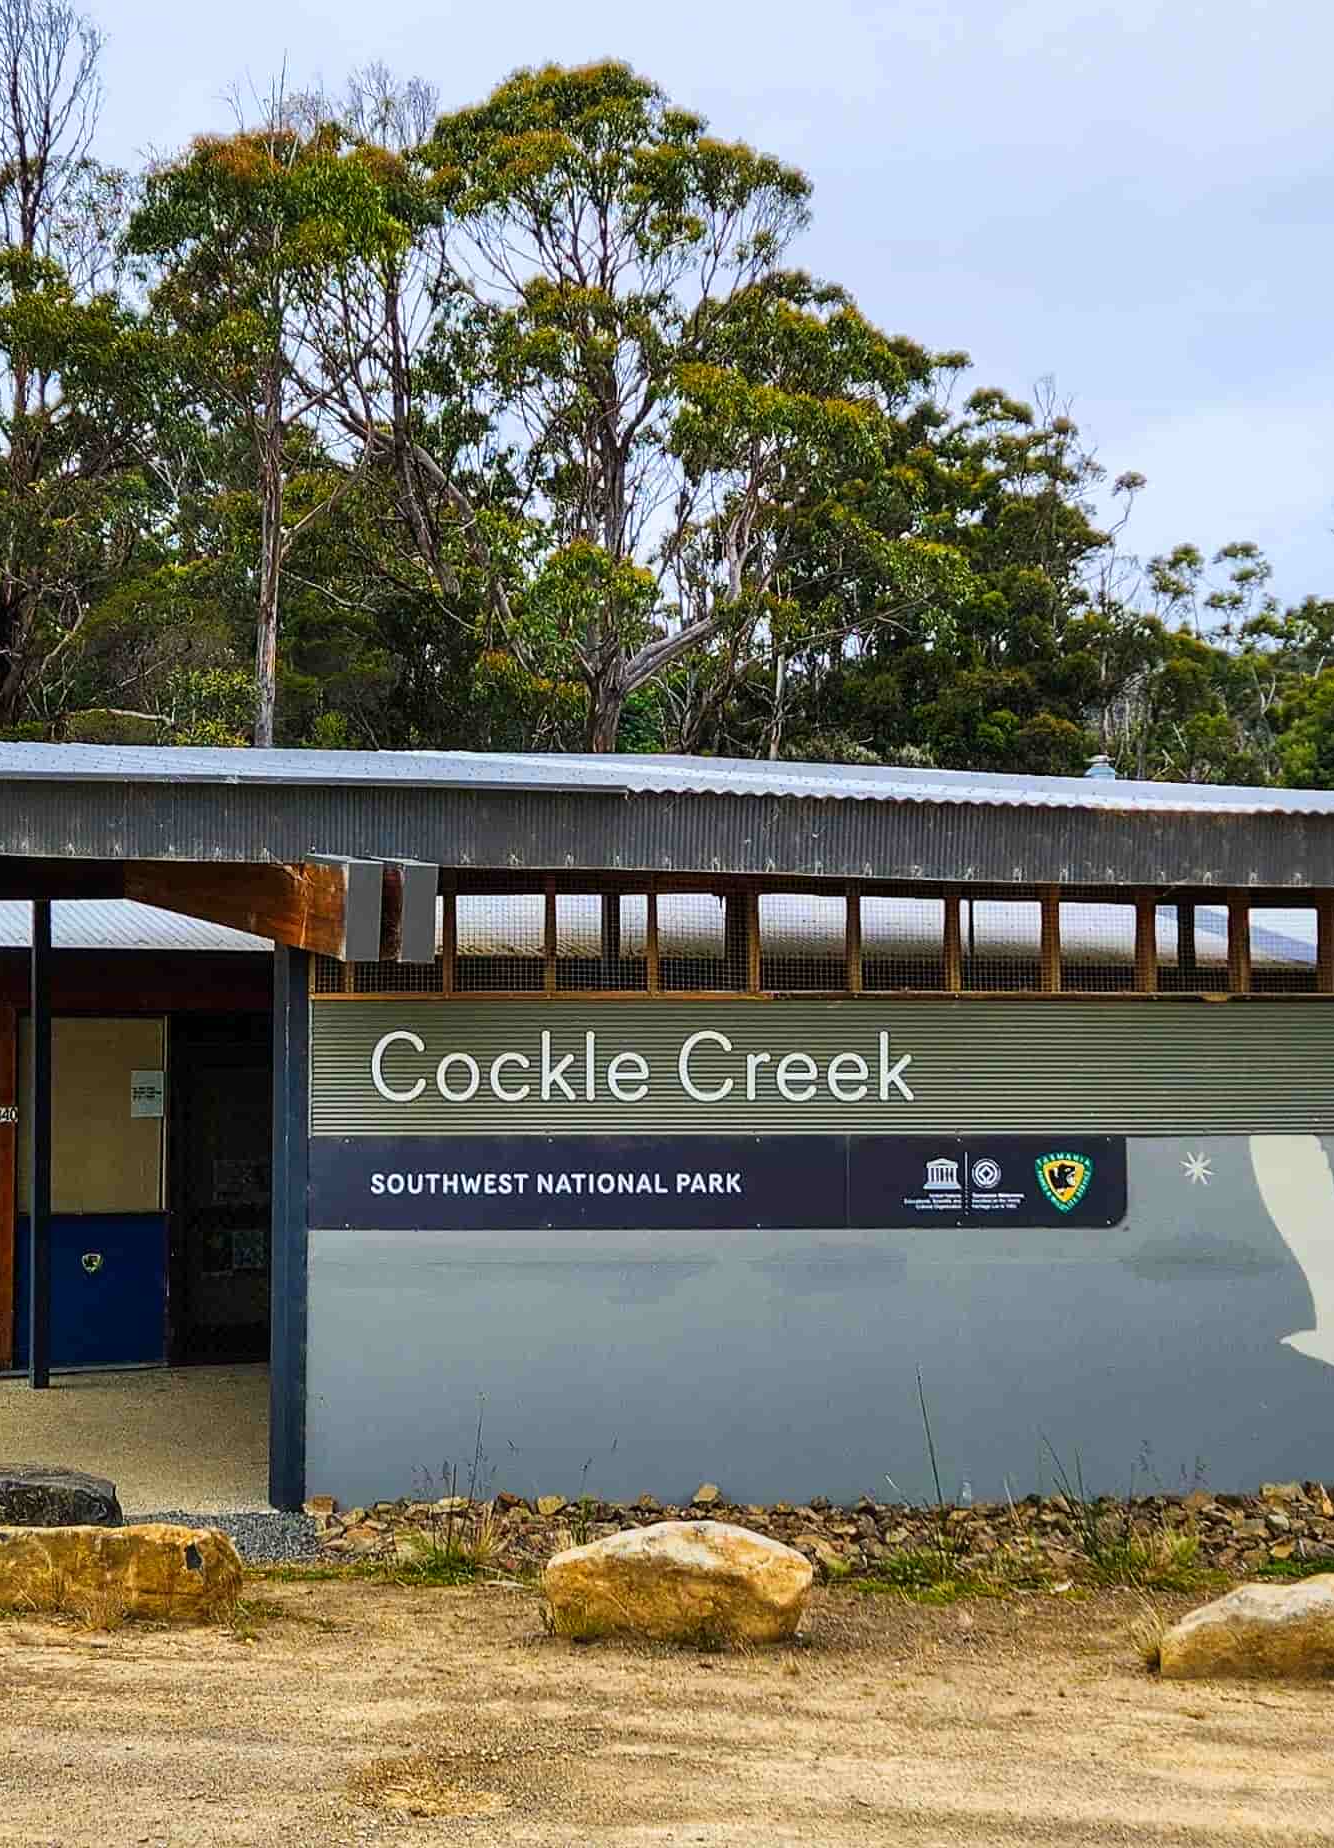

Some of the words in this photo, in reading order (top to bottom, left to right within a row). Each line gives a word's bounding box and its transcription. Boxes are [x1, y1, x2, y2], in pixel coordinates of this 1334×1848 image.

[370, 1030, 650, 1102] Cockle
[677, 1030, 915, 1102] Creek
[370, 1172, 529, 1194] SOUTHWEST
[537, 1172, 668, 1194] NATIONAL
[676, 1172, 741, 1194] PARK
